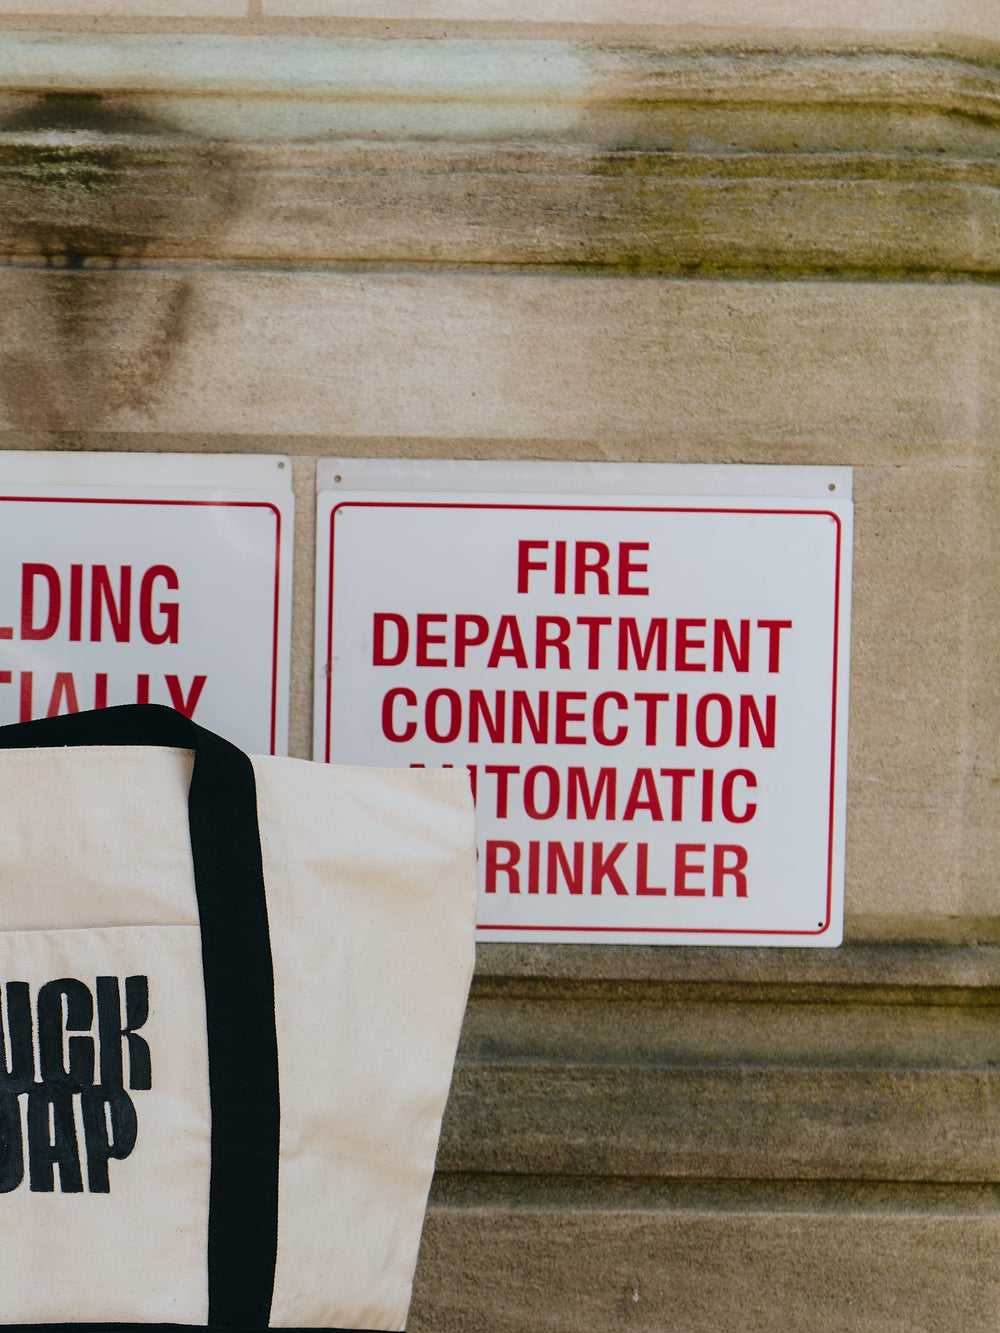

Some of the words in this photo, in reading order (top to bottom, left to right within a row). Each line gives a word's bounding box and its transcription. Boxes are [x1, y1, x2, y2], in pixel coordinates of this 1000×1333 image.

[516, 540, 650, 597] FIRE
[371, 612, 793, 674] DEPARTMENT
[381, 687, 777, 750] CONNECTION
[409, 764, 759, 825] TOMATIC
[476, 839, 750, 899] RINKLER
